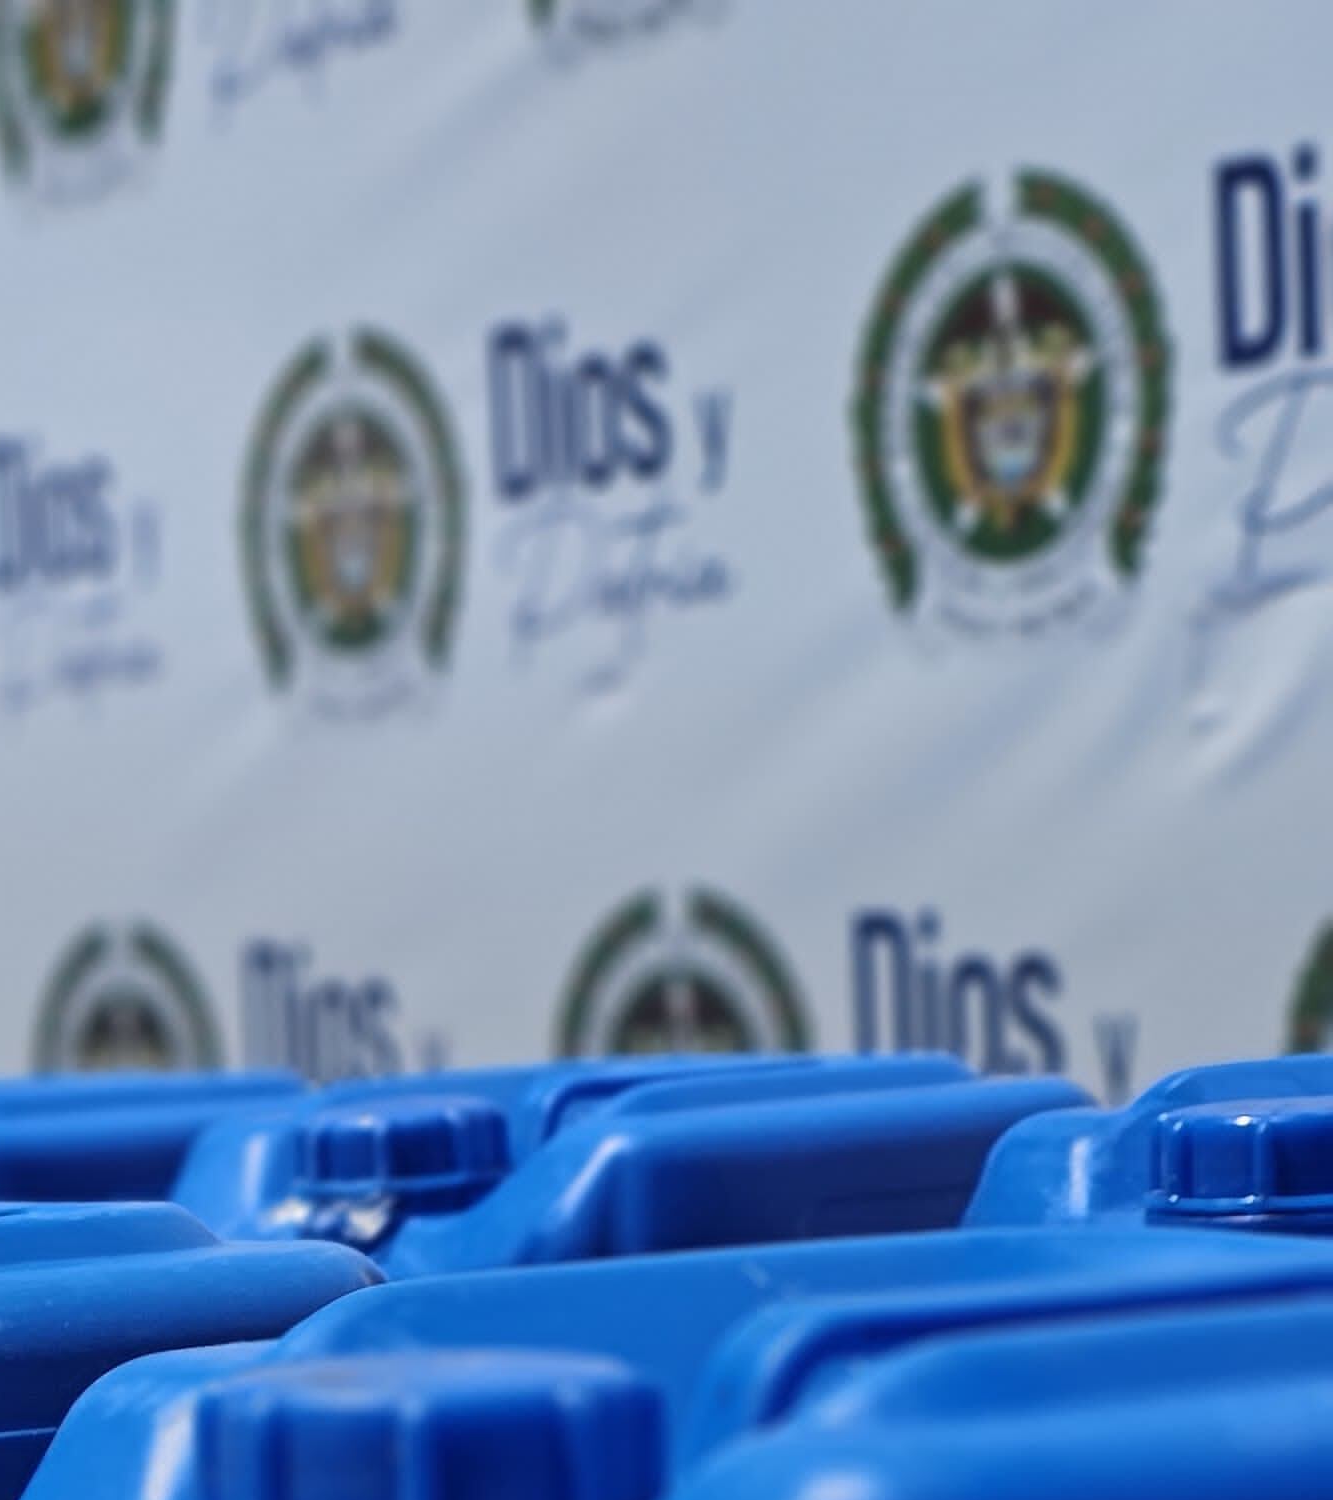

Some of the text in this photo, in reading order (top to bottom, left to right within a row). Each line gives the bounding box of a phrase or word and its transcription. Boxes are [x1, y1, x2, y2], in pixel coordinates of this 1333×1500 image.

[1215, 142, 1333, 372] Di
[488, 318, 671, 502] Dios
[849, 905, 1067, 1076] Dios
